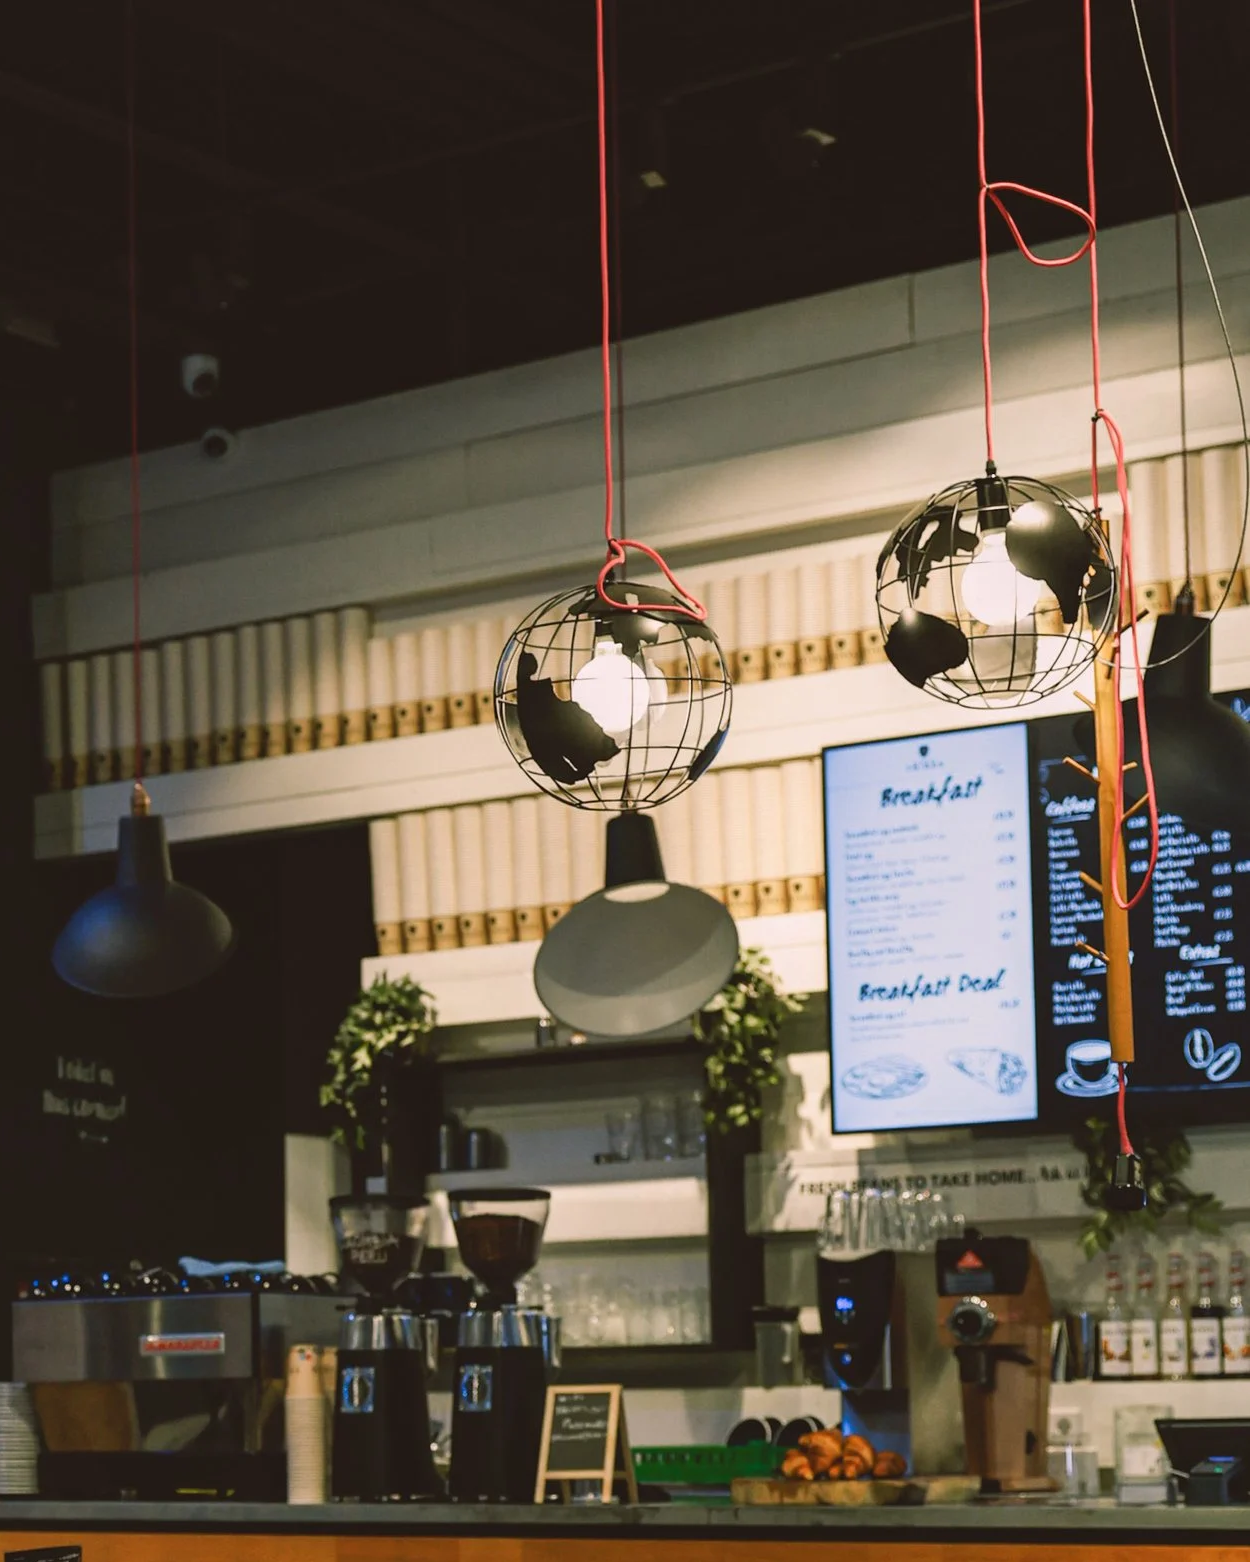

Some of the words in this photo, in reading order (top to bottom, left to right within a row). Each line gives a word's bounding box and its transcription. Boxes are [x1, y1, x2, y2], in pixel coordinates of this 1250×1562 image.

[880, 776, 982, 808] Breakfast
[857, 974, 952, 1004] Breakfast
[958, 967, 1006, 992] Deal
[905, 1174, 927, 1190] TO
[930, 1171, 972, 1187] TAKE
